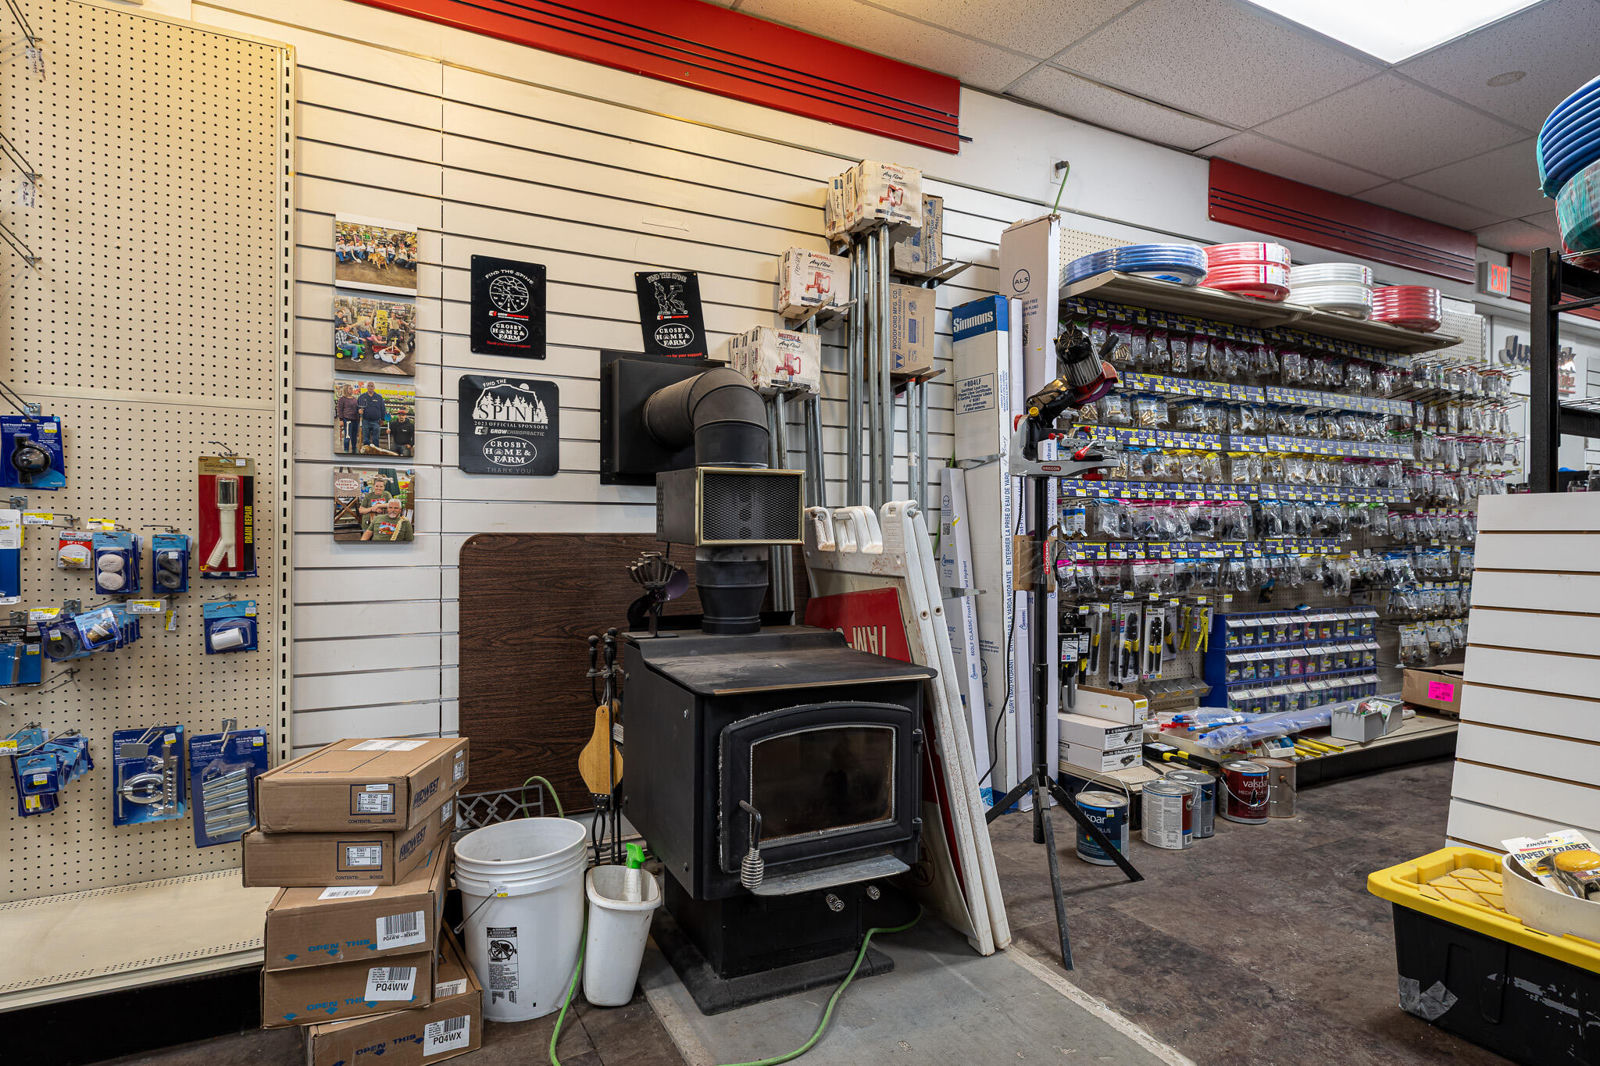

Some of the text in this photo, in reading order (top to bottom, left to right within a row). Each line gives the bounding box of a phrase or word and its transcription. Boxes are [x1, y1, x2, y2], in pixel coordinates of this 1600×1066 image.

[514, 271, 534, 285] SPINE
[1491, 264, 1508, 293] EXIT
[953, 311, 994, 332] Simmons
[478, 404, 542, 422] SPINE
[244, 505, 253, 544] DRAIN REPAIR
[1513, 850, 1546, 861] PAPER
[308, 939, 370, 952] OPEN THIS
[376, 983, 409, 992] PQ4WW
[306, 996, 366, 1011] OPEN THI
[356, 1033, 417, 1056] OPEN THIS
[433, 1031, 462, 1045] PQ4WX
